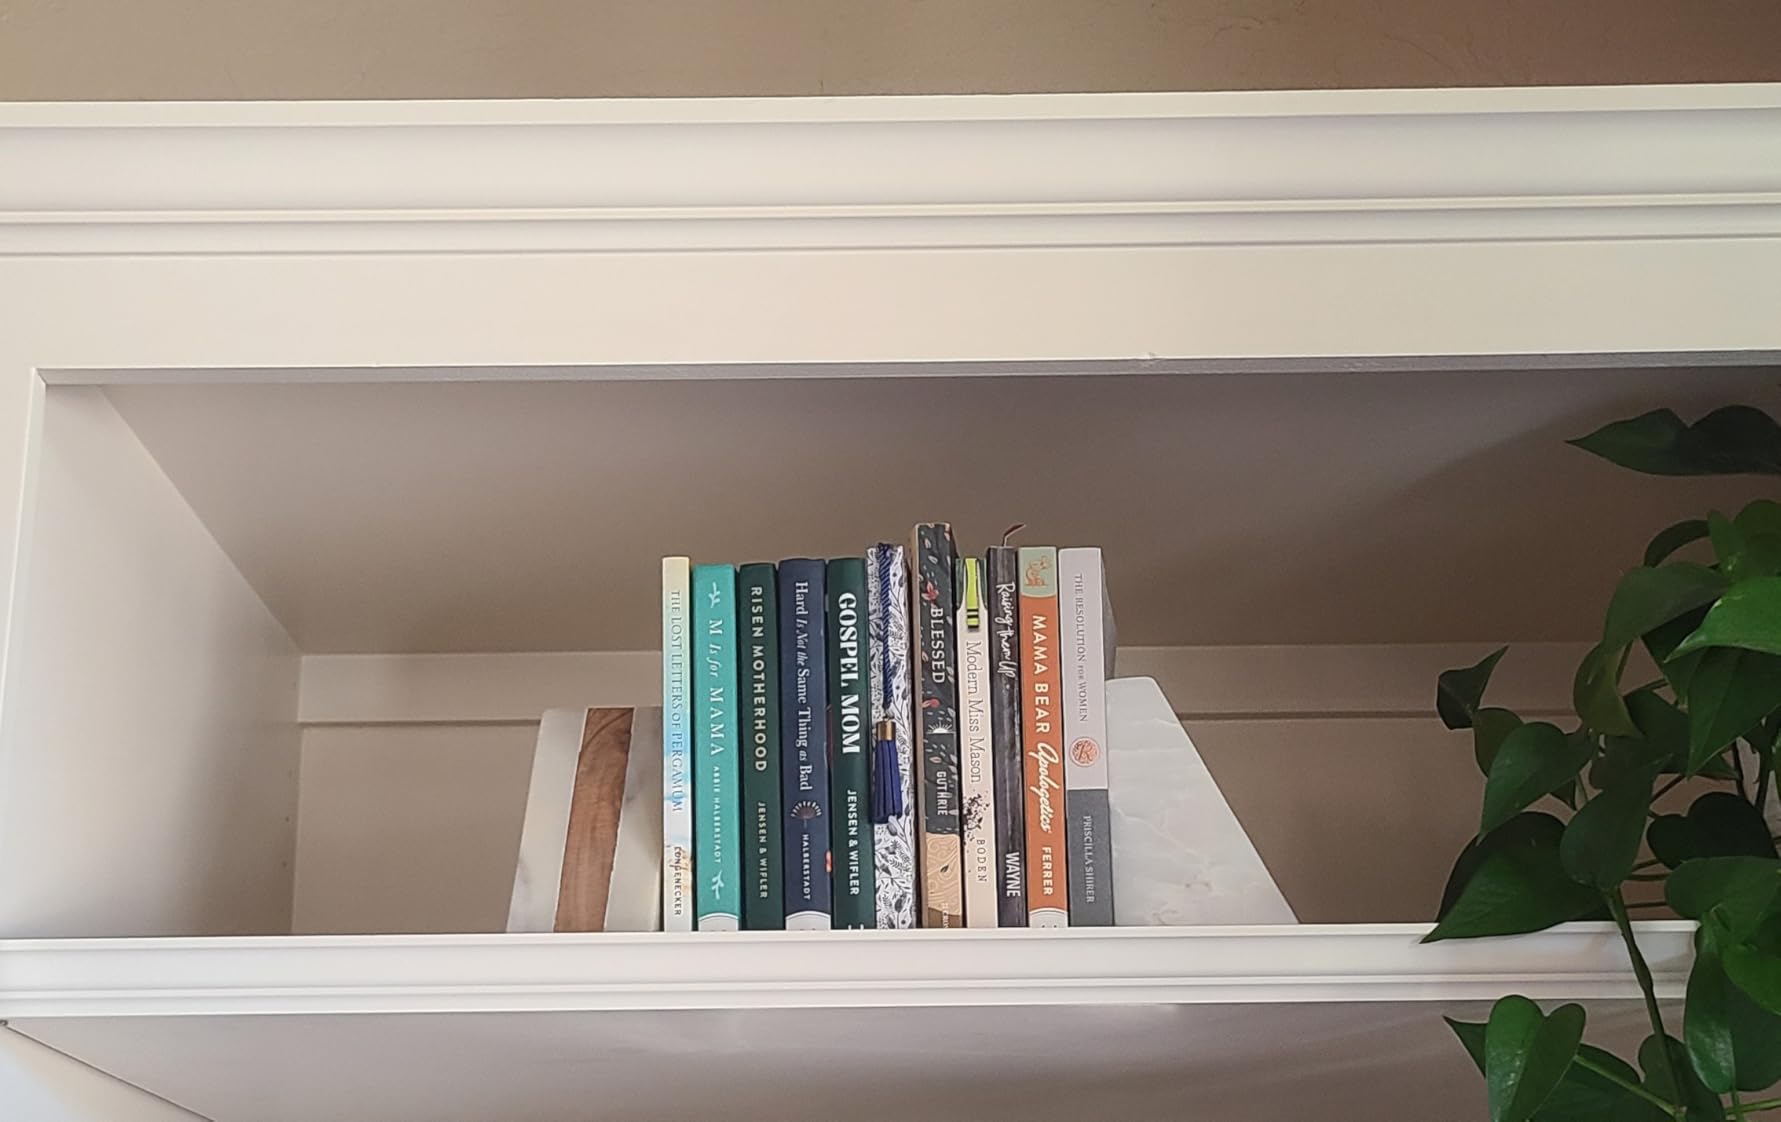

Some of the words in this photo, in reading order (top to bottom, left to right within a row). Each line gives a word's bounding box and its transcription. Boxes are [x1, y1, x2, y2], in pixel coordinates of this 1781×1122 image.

[671, 591, 681, 614] THE
[795, 582, 809, 615] Hard
[995, 582, 1016, 626] Raising
[1074, 574, 1083, 595] THE
[671, 616, 682, 649] LOST
[708, 619, 723, 634] M
[751, 587, 764, 637] RISEN
[797, 617, 808, 628] Is
[1074, 598, 1086, 663] RESOLUTION
[709, 643, 722, 654] Is
[796, 628, 809, 649] Not
[797, 650, 809, 666] the
[838, 592, 859, 688] GOSPEL
[930, 607, 946, 684] BLESSED
[1032, 615, 1048, 675] MAMA
[671, 653, 683, 708] LETTERS
[707, 656, 722, 678] for
[797, 666, 810, 704] Same
[966, 641, 981, 695] Modern
[672, 714, 682, 729] OF
[710, 688, 725, 756] MAMA
[752, 646, 767, 771] MOTHERHOOD
[841, 694, 861, 754] MOM
[967, 697, 982, 732] Miss
[1033, 683, 1050, 733] BEAR
[1078, 683, 1089, 722] WOMEN
[796, 707, 812, 748] Thing
[672, 734, 683, 812] PERGAMUM
[799, 749, 808, 761] as
[799, 763, 813, 790] Bad
[970, 738, 986, 783] Mason
[713, 766, 721, 793] ABBIE
[936, 771, 948, 816] GUTHRIE
[1029, 742, 1060, 833] Apologetics
[713, 795, 722, 863] HALBERSTADT
[758, 802, 767, 843] JENSEN
[847, 790, 859, 835] JENSEN
[848, 838, 859, 847] &
[976, 839, 988, 883] BODEN
[1083, 815, 1093, 863] PRISCILLA
[759, 858, 768, 898] WIFLER
[802, 834, 811, 900] HALBERSTADT
[849, 848, 861, 896] WIFLER
[1005, 852, 1021, 897] WAYNE
[1041, 847, 1053, 896] FERRER
[1085, 865, 1095, 903] SHIRER
